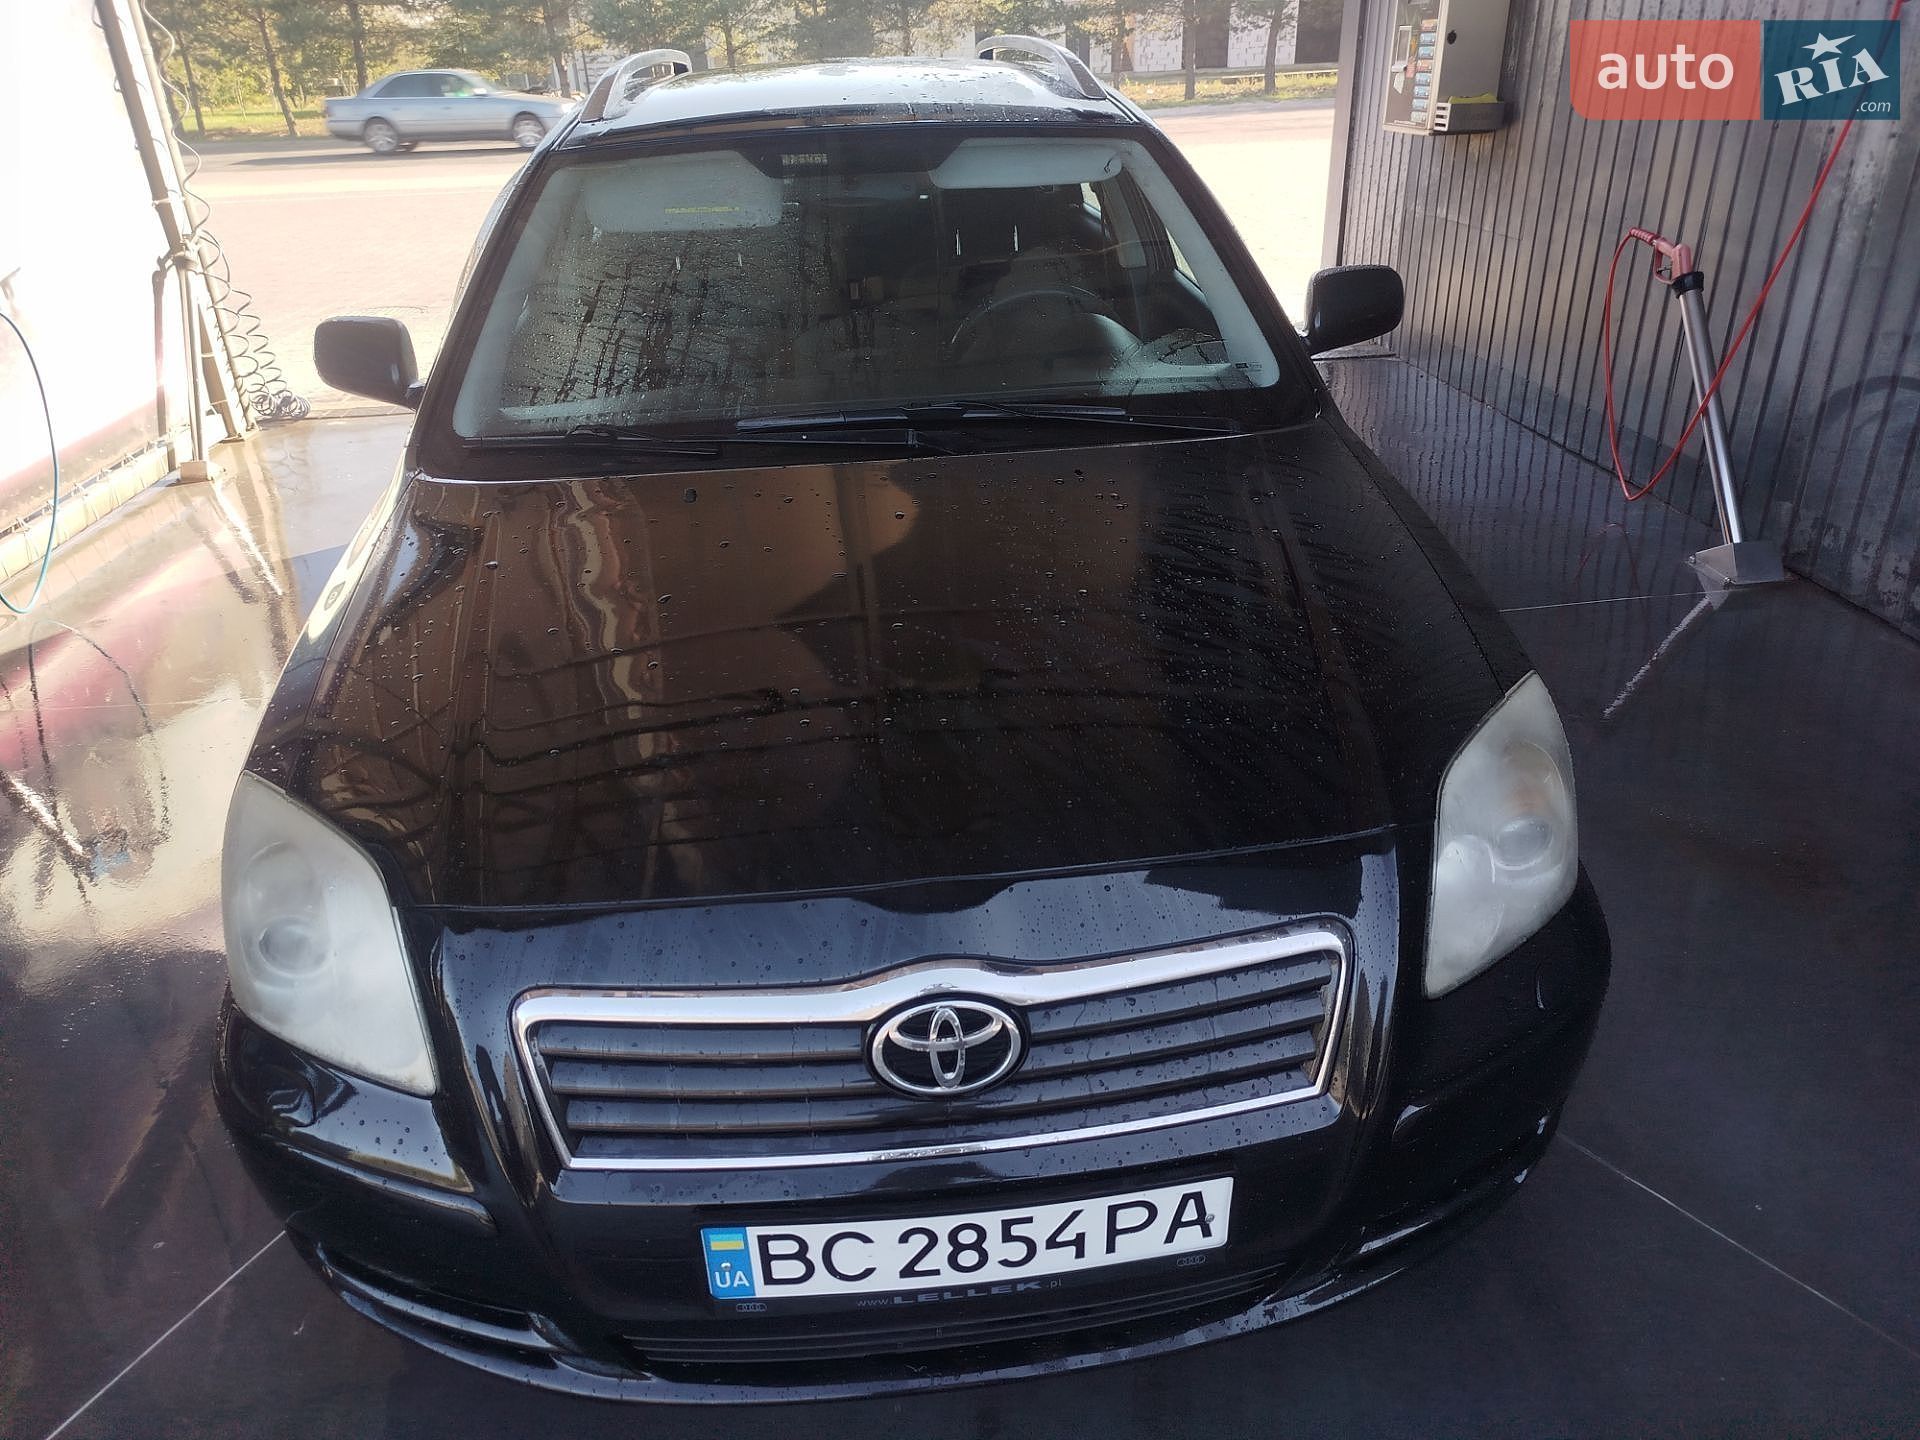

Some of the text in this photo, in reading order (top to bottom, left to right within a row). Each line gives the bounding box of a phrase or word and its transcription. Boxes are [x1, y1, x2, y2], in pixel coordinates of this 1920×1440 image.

[757, 1190, 1213, 1286] BC 2854 PA
[714, 1270, 750, 1288] UA
